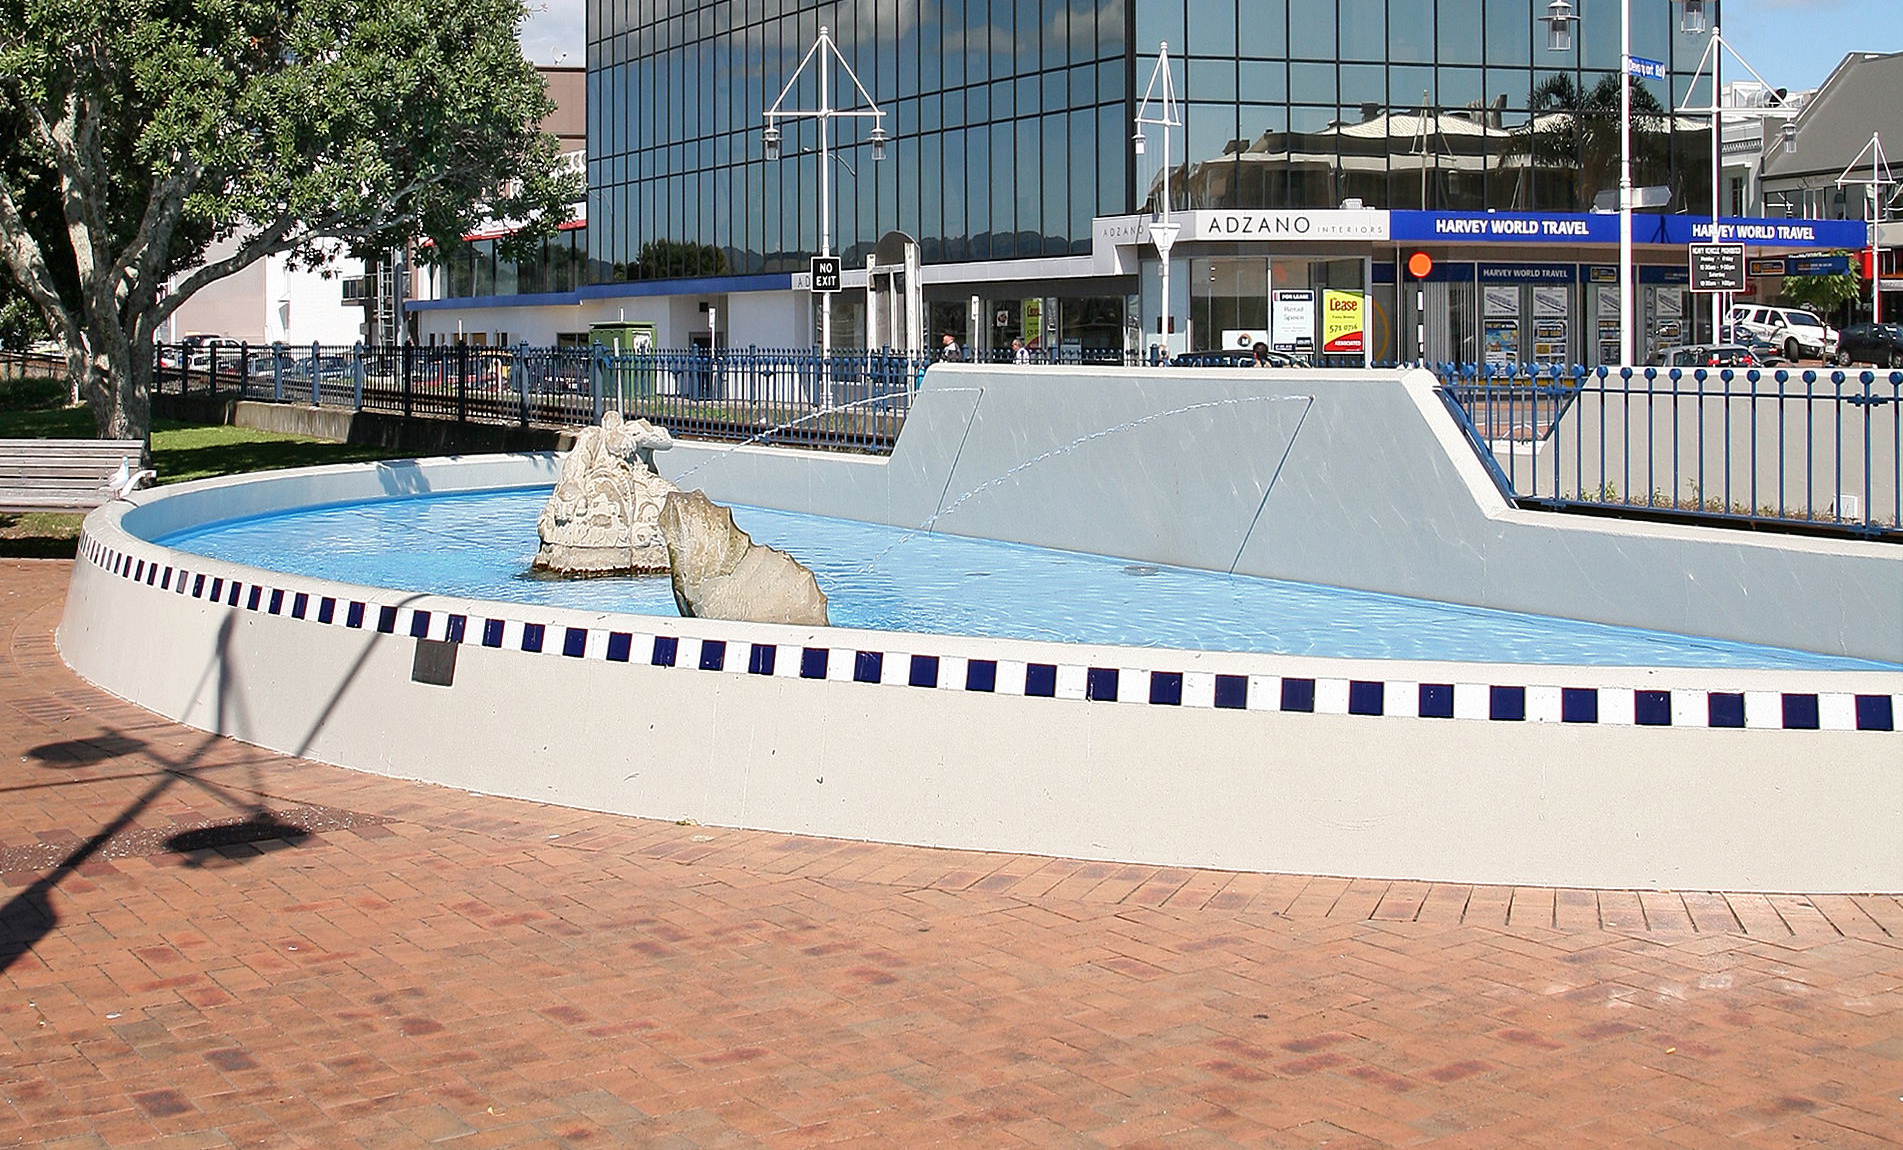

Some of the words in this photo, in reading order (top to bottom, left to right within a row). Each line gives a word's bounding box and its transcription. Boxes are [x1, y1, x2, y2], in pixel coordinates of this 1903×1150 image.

[1103, 225, 1144, 237] ADZANO
[1208, 216, 1310, 233] ADZANO
[1435, 219, 1488, 234] HARVEY
[1490, 220, 1539, 234] WORLD
[1541, 221, 1590, 235] TRAVEL
[1736, 225, 1775, 239] WORLD
[1777, 226, 1815, 240] TRAVEL
[819, 262, 833, 274] NO
[1483, 269, 1512, 277] HARVEY
[1513, 269, 1541, 278] WORLD
[1542, 269, 1568, 278] TRAVEL
[816, 275, 837, 287] EXIT
[1329, 298, 1358, 312] Lease
